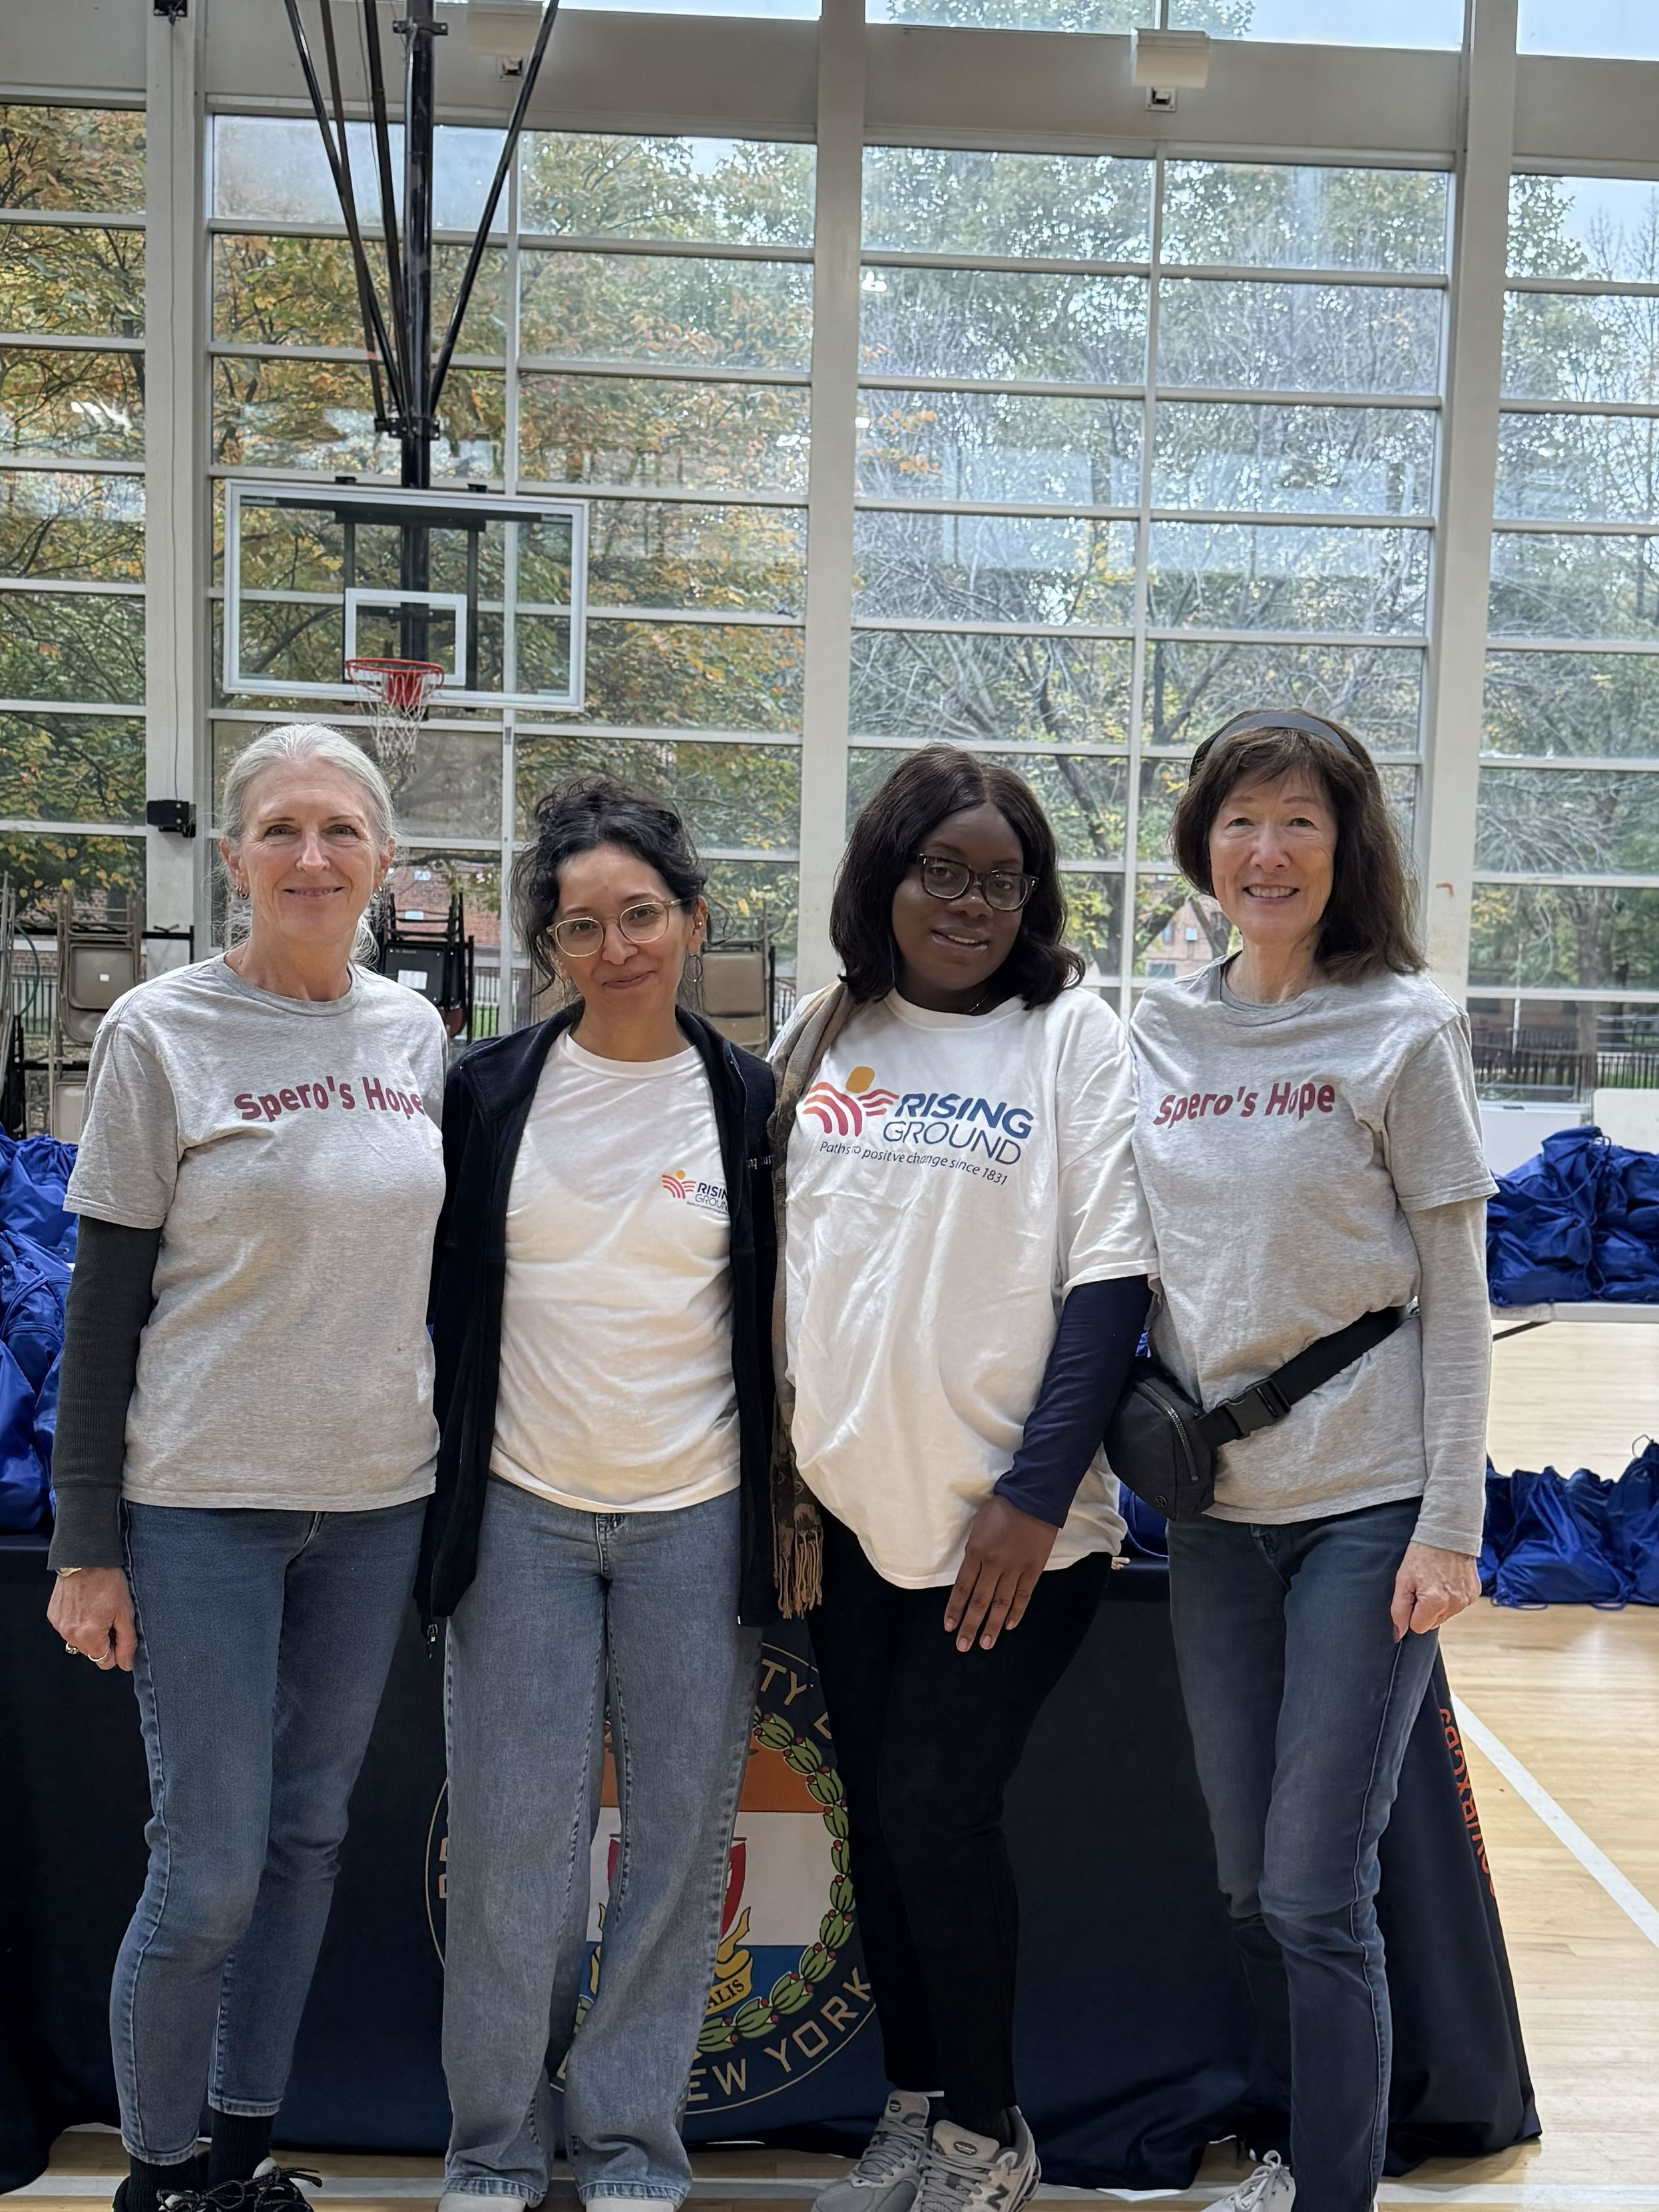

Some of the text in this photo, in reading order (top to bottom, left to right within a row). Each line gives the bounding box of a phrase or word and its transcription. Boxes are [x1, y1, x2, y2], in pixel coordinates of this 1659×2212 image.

[234, 1076, 425, 1122] Spero's Hope
[895, 1093, 1034, 1139] RISING
[1152, 1082, 1335, 1130] Spero's Hope
[820, 1141, 850, 1155] Paths
[906, 1152, 948, 1167] change
[949, 1158, 980, 1175] since
[982, 1168, 1008, 1186] 1831
[883, 1121, 1022, 1165] GROUND
[695, 1194, 728, 1210] GROUN
[697, 1182, 728, 1200] RISIN
[760, 1658, 808, 1705] TY
[707, 1979, 744, 2009] ALIS
[687, 1966, 871, 2101] EW YORK
